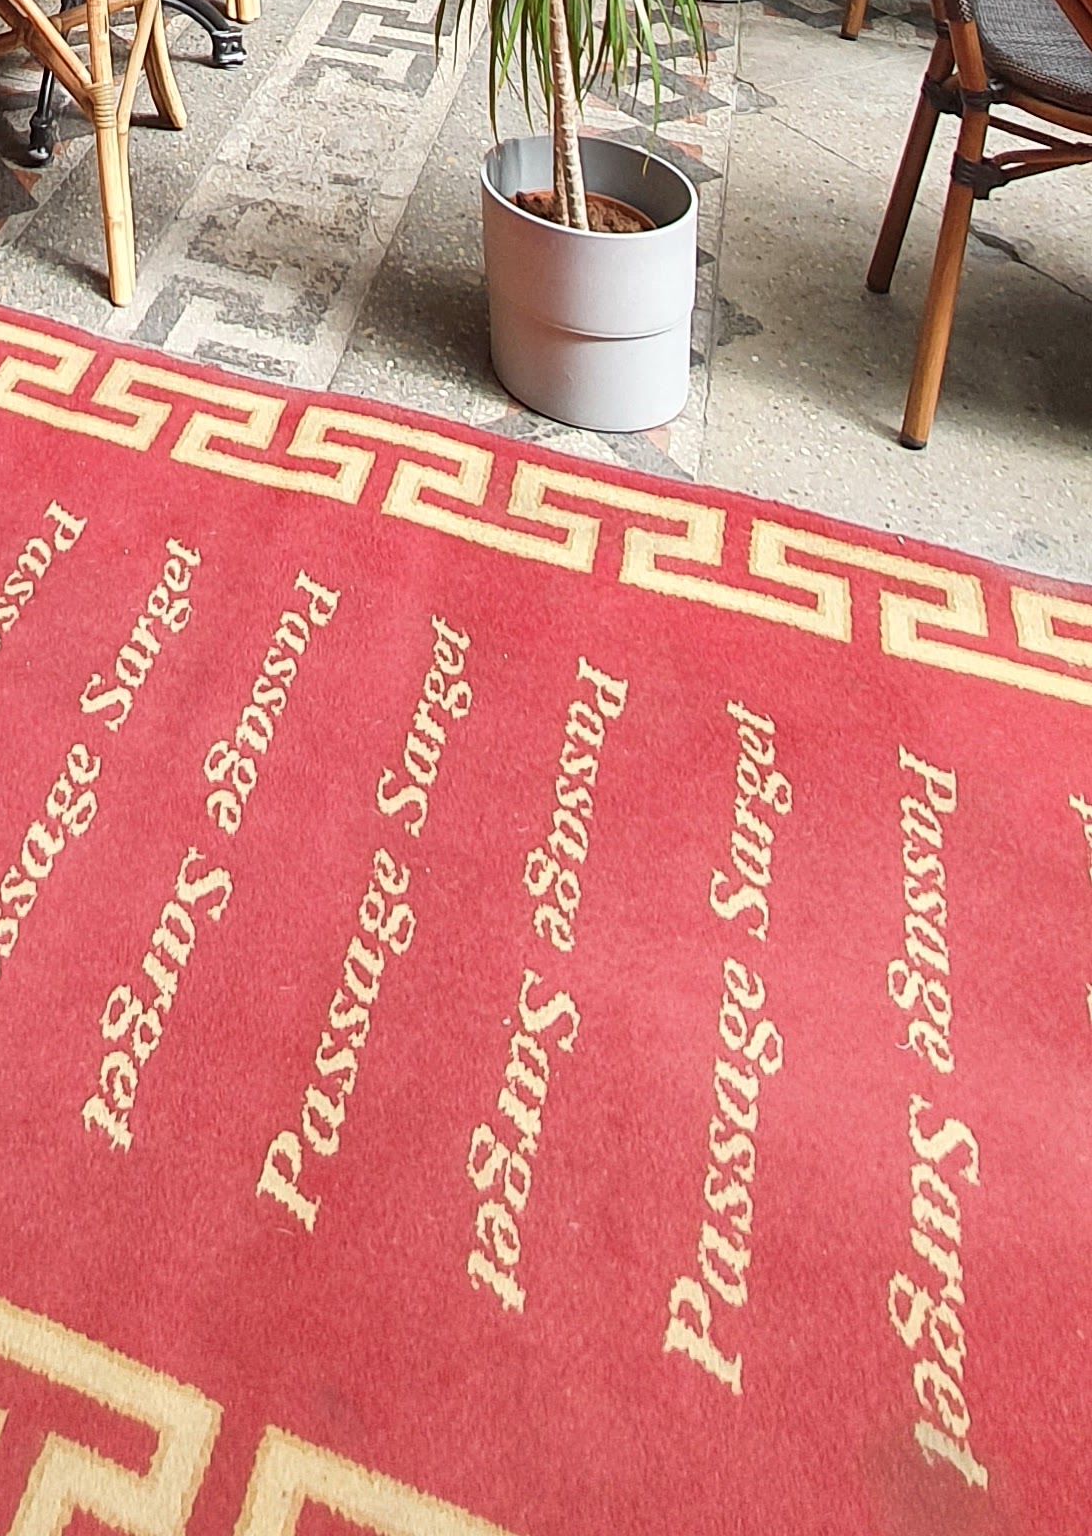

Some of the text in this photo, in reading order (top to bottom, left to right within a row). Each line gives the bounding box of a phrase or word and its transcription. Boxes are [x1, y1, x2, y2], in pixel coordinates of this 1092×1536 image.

[77, 537, 203, 734] Sarget
[79, 569, 343, 1154] Passage Sarget
[253, 614, 474, 1235] Passage Sarget
[463, 655, 630, 1314] Passage Sarget
[661, 699, 794, 1397] Passage Sarget
[884, 744, 991, 1492] Passage Sarget
